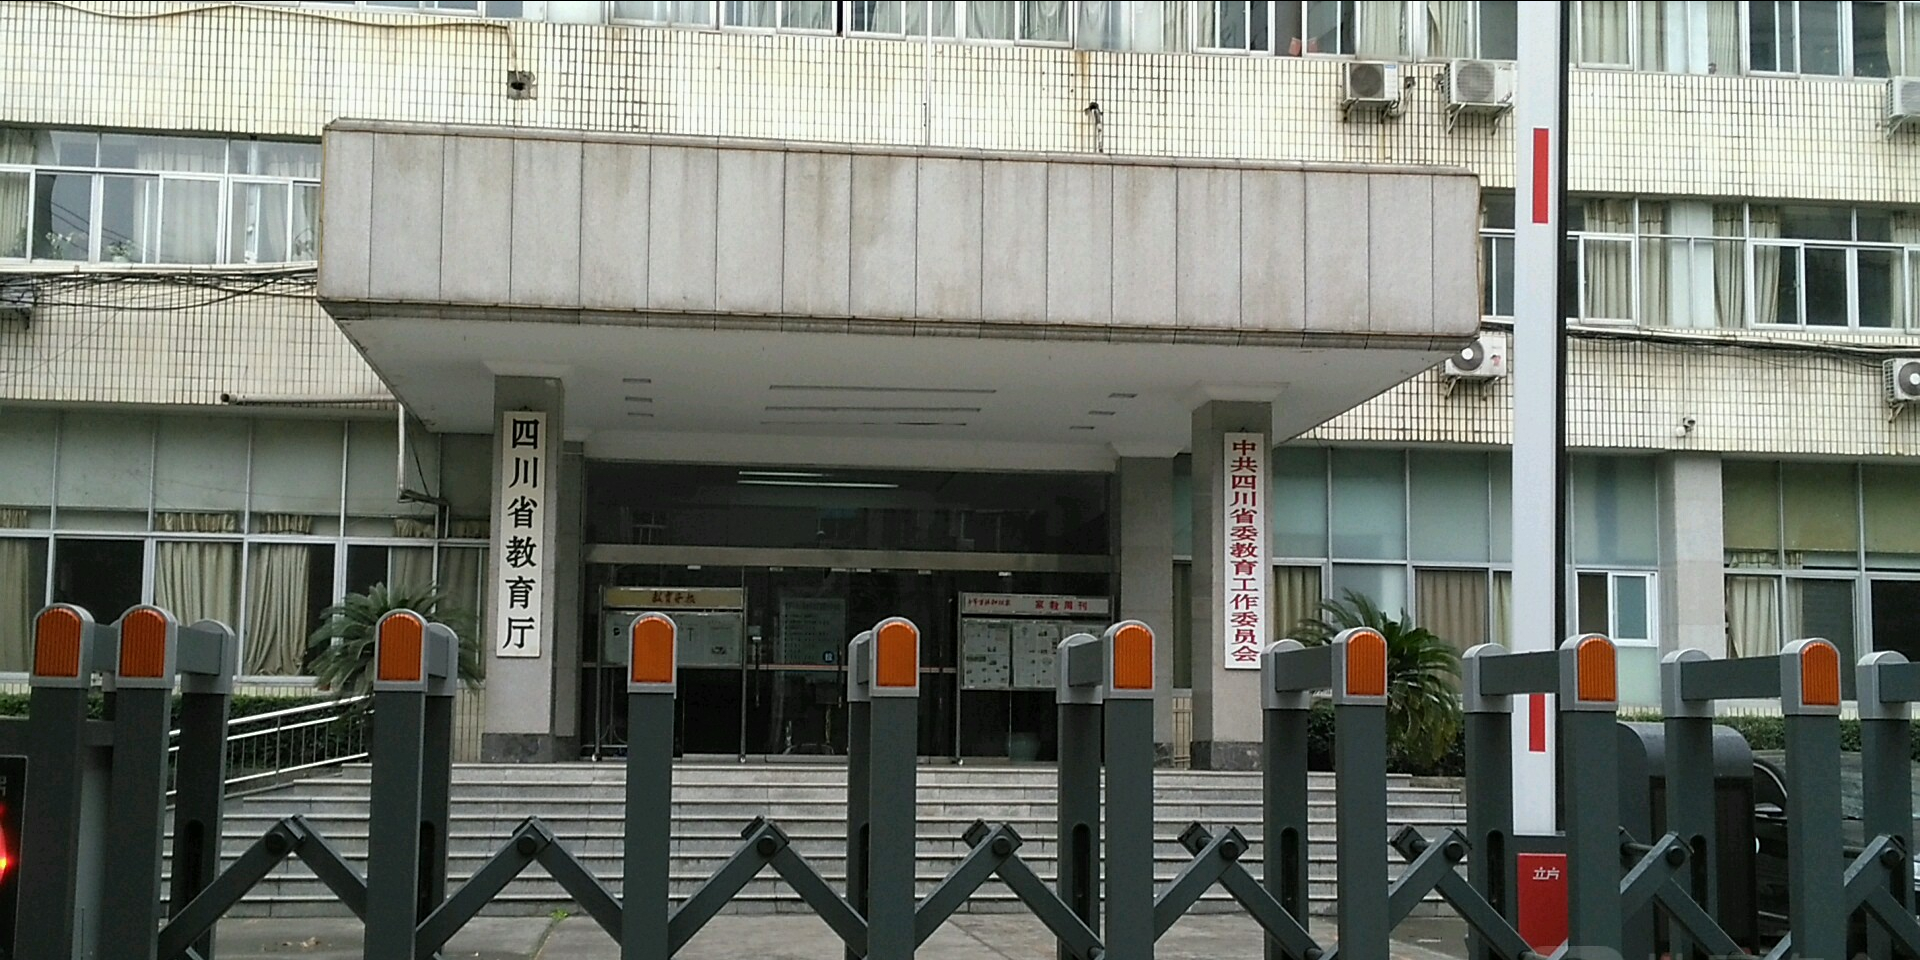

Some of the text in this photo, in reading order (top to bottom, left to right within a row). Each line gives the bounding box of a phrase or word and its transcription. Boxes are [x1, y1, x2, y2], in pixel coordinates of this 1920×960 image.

[502, 418, 540, 650] 四川省教育厅
[1035, 600, 1088, 611] 家教周刊
[1229, 439, 1260, 662] 中共四川省委教育工作委员会
